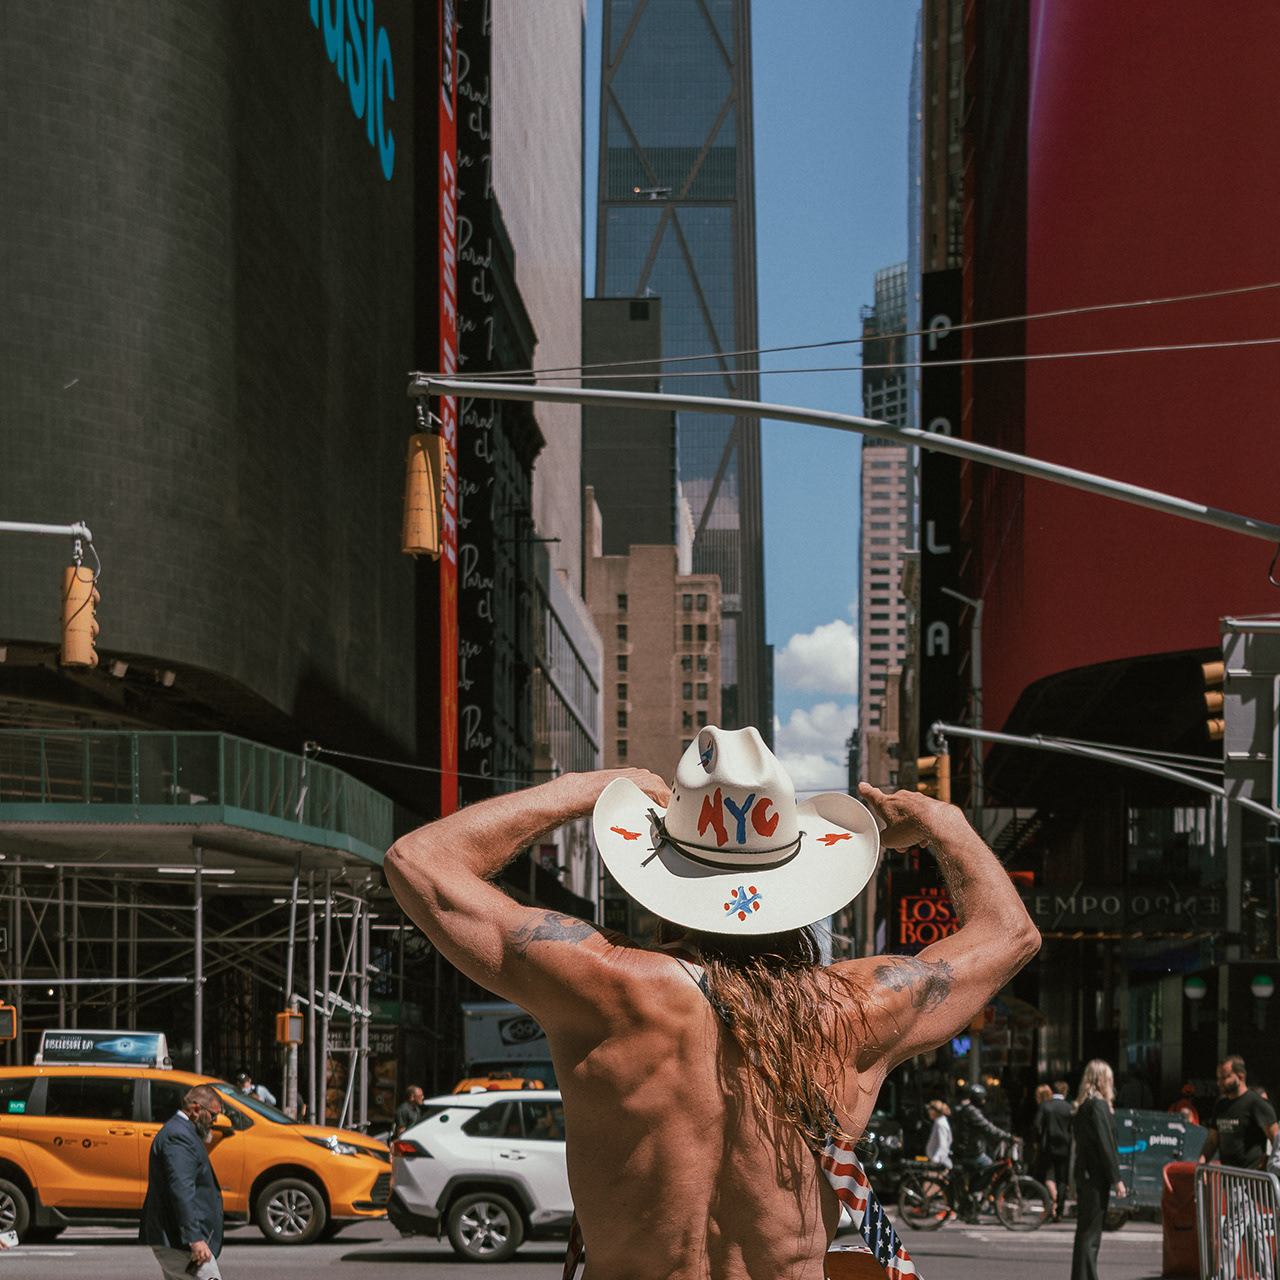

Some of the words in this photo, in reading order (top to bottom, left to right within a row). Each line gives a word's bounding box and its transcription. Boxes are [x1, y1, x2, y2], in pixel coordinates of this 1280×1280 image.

[309, 0, 396, 181] usic
[697, 787, 779, 847] NYC
[1034, 894, 1121, 916] EMPO
[1149, 1134, 1178, 1147] prime
